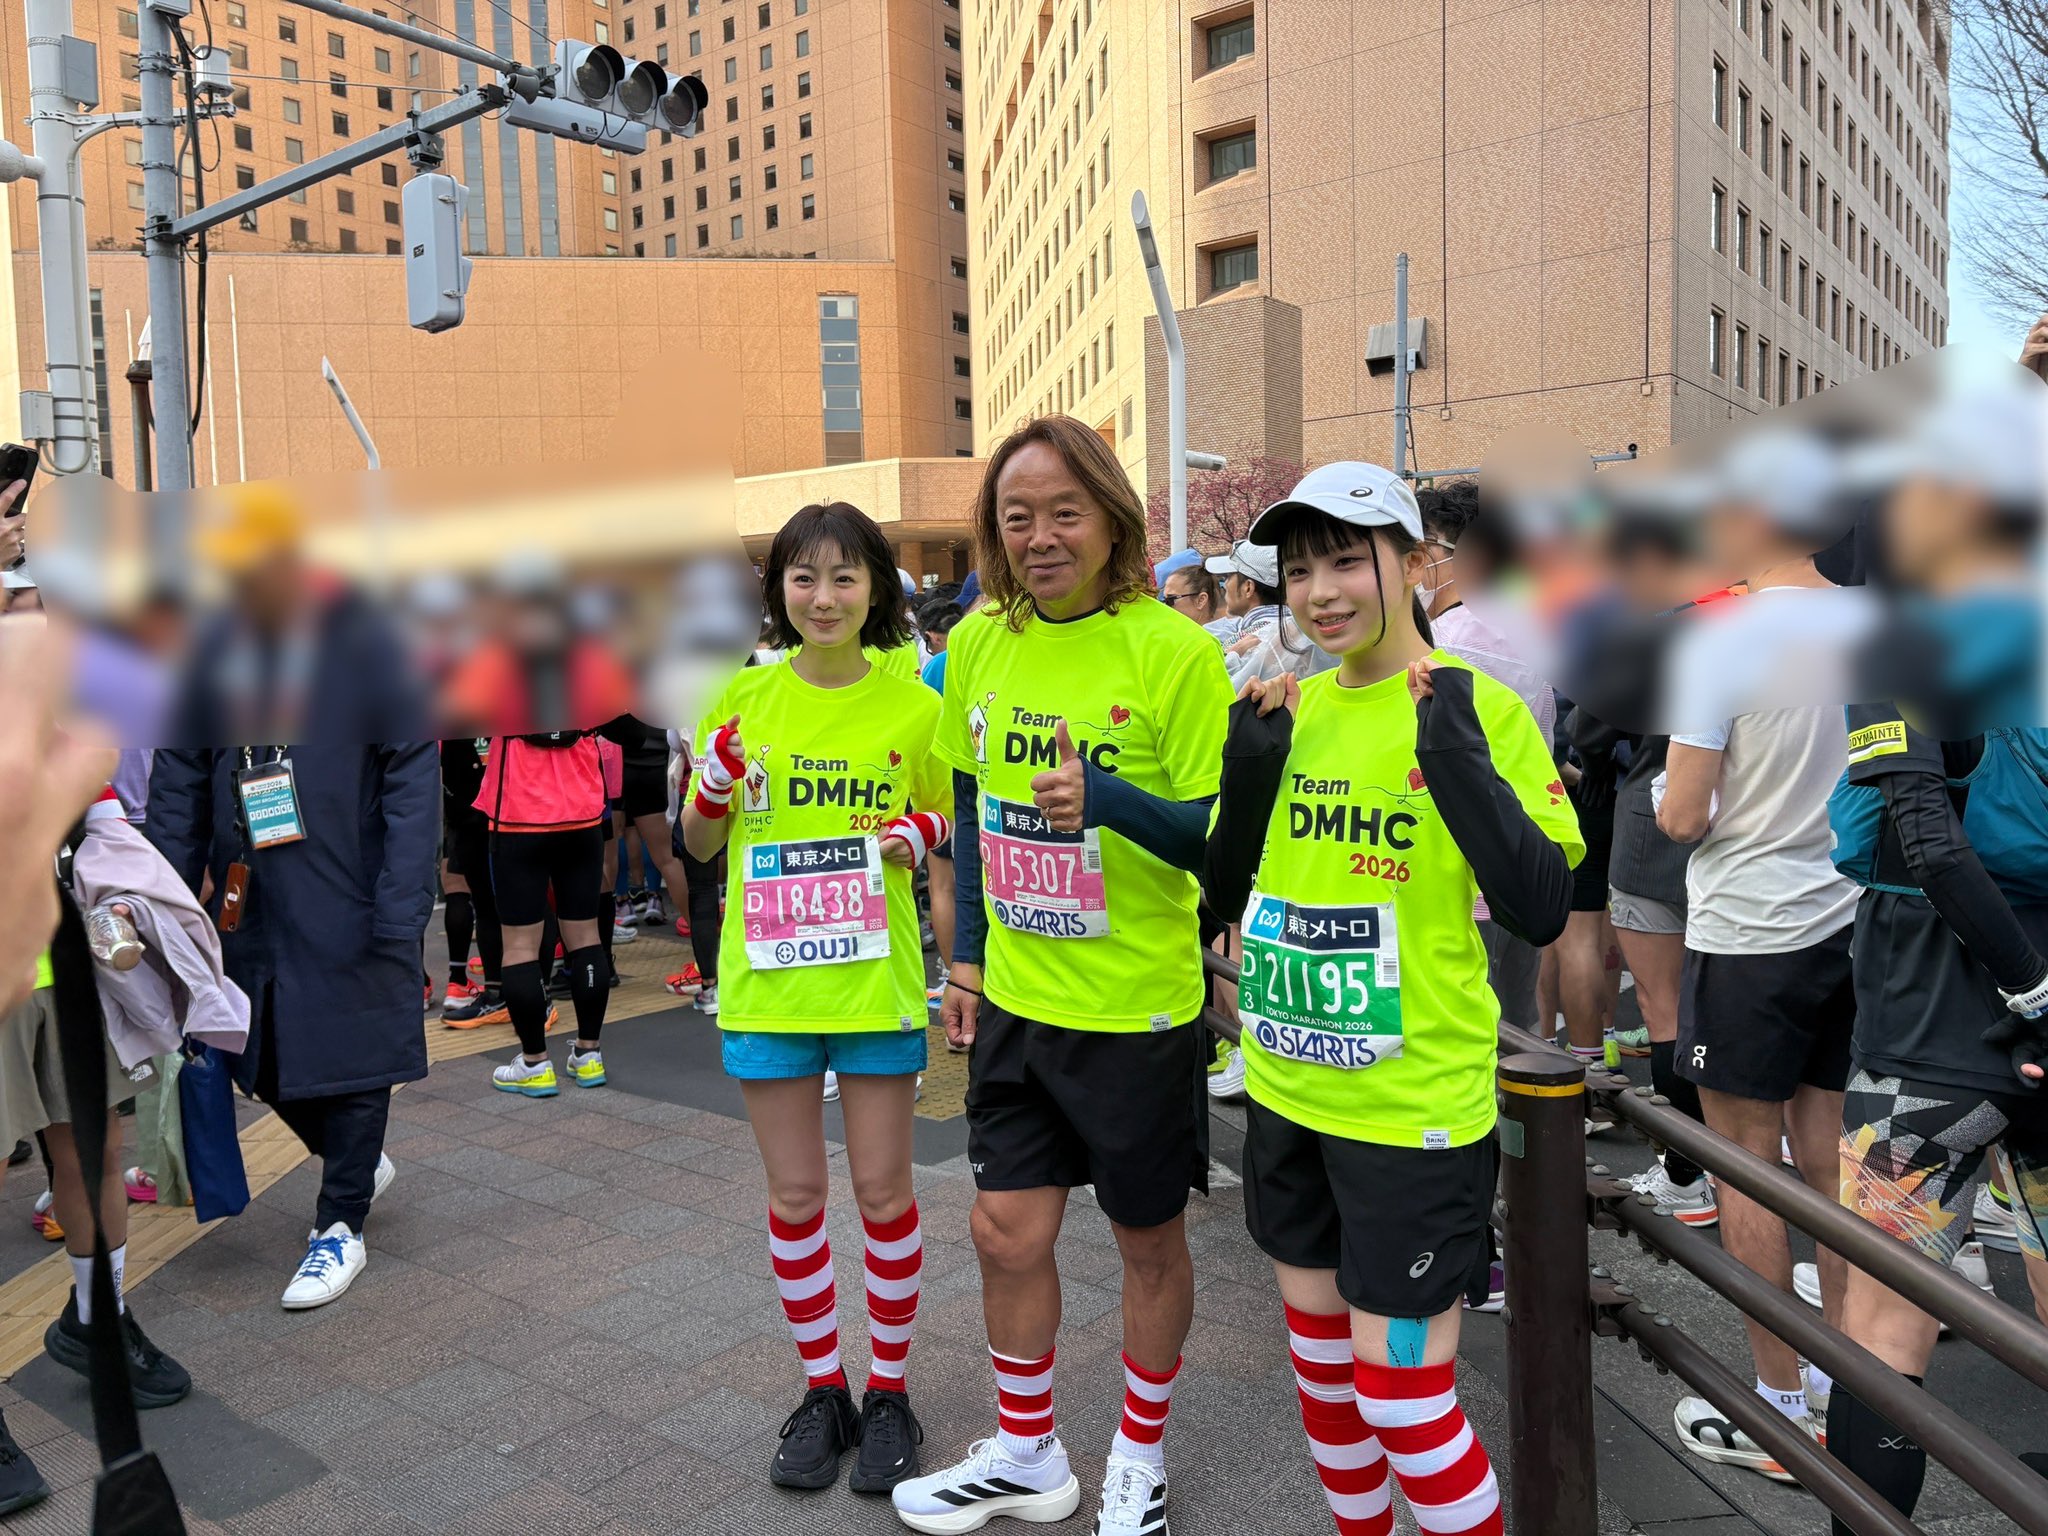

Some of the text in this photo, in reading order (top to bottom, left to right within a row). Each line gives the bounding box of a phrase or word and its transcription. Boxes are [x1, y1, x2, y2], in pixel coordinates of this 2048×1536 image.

[1012, 706, 1063, 728] Team
[790, 754, 848, 771] Team
[1005, 731, 1121, 774] DMC
[789, 777, 893, 811] DMHC
[1292, 773, 1350, 795] Team
[849, 814, 884, 831] 202
[1290, 803, 1418, 850] DMHC
[786, 847, 861, 867] 東京メトロ
[1000, 844, 1076, 895] 15307
[1349, 853, 1410, 883] 2026
[747, 892, 764, 913] D
[776, 879, 865, 925] 18438
[752, 923, 763, 939] 3
[1011, 904, 1087, 936] STARTS
[1287, 914, 1370, 939] 東京メトロ
[799, 936, 859, 961] OUJI
[1242, 951, 1257, 977] D
[1264, 952, 1369, 1015] 21195
[1244, 991, 1254, 1010] 3
[1265, 1005, 1373, 1031] TOKYO MARATHON 2026
[1280, 1026, 1377, 1067] STARTS
